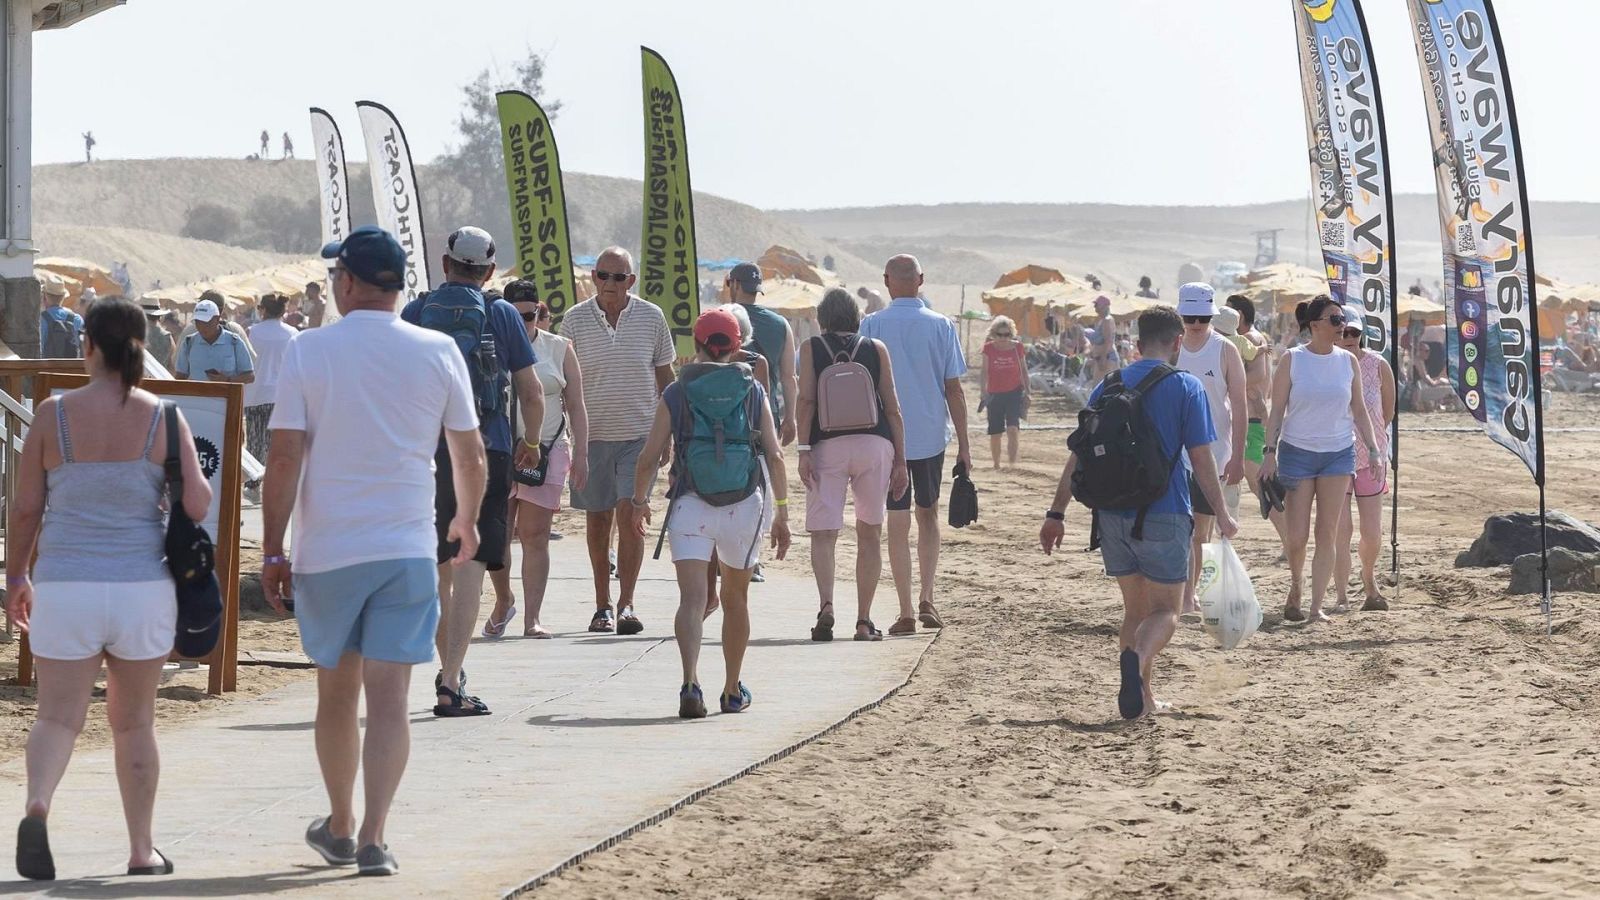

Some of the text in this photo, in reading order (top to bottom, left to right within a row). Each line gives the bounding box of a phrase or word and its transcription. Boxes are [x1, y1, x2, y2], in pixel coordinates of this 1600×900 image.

[509, 123, 536, 281] SURFMASPALO
[527, 117, 566, 335] SURF-SCHOO
[199, 452, 214, 469] 5€
